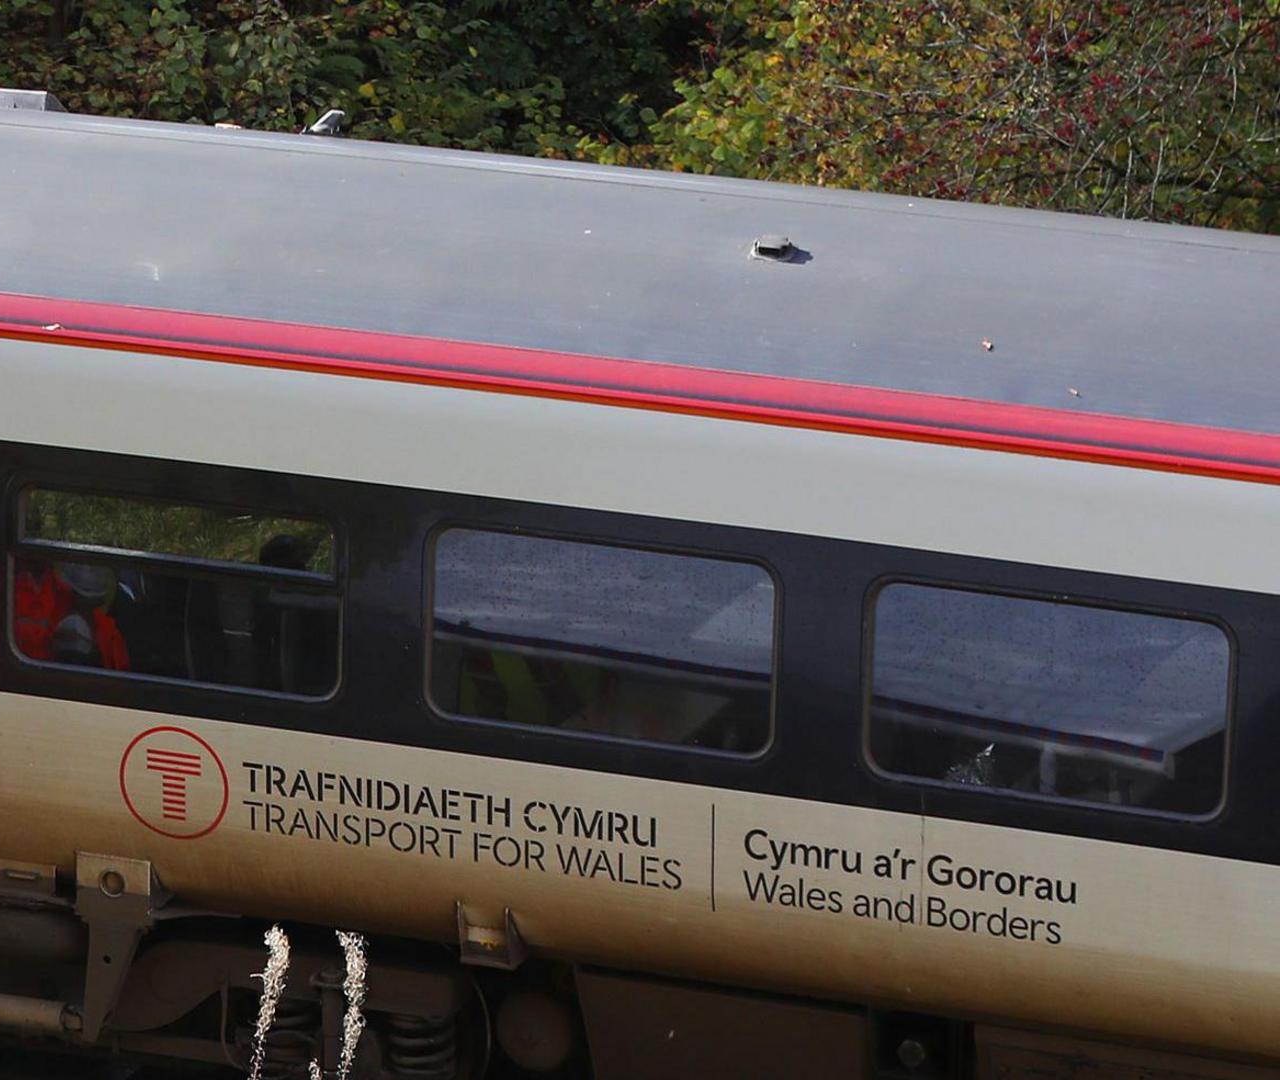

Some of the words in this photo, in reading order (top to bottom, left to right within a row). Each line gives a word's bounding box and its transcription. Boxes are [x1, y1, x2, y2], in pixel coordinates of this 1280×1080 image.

[242, 761, 512, 828] TRAFNIDIAETH
[523, 801, 657, 848] CYMRU
[242, 801, 462, 859] TRANSPORT
[472, 832, 545, 872] FOR
[554, 843, 683, 892] WALES
[743, 828, 862, 875] Cymru
[873, 848, 916, 881] a'r
[926, 854, 1078, 905] Gororau
[743, 869, 842, 914] Wales
[853, 893, 915, 924] and
[926, 896, 1063, 945] Borders
